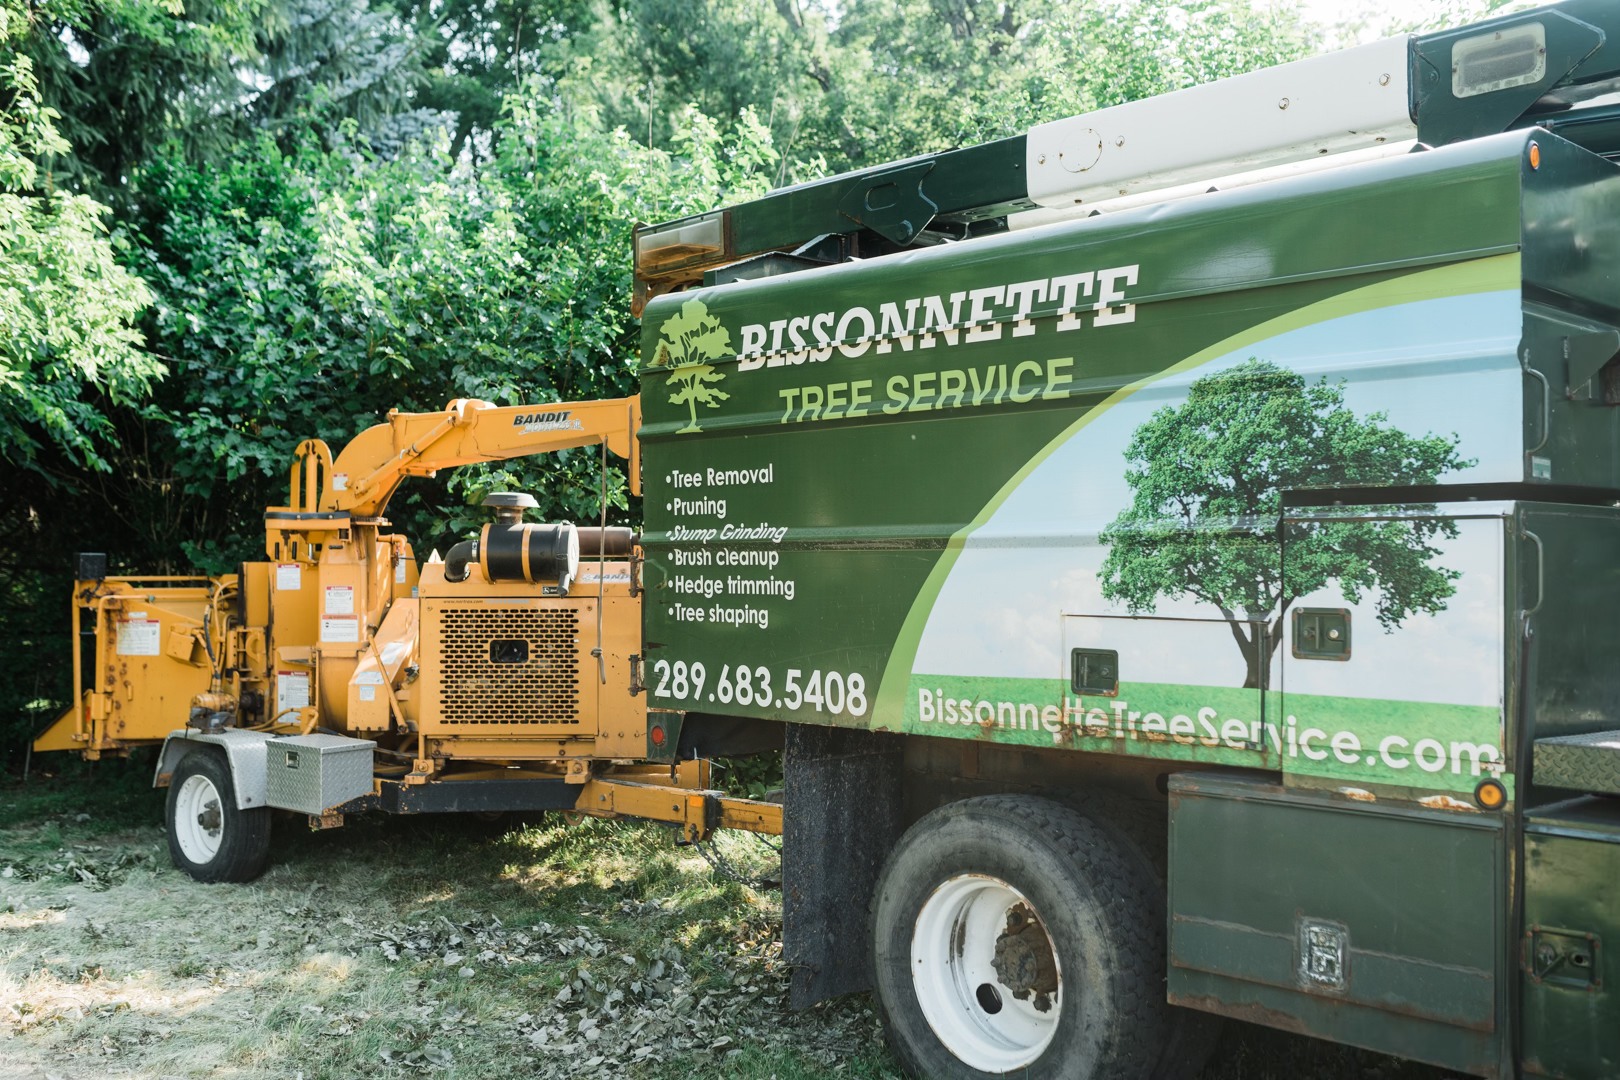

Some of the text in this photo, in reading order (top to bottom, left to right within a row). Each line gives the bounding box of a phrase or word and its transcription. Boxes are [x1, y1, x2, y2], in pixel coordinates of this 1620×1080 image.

[737, 264, 1140, 372] BISSONNETTE
[779, 357, 1074, 423] TREE SERVICE
[513, 411, 571, 426] BANDIT
[672, 463, 774, 488] Tree Removal
[673, 496, 726, 518] Pruning
[670, 522, 788, 544] Stump Grinding
[674, 547, 779, 570] Brush cleanup
[675, 575, 795, 600] Hedge trimming
[675, 603, 769, 629] Tree shaping
[653, 659, 868, 717] 289.683.5408
[918, 688, 1502, 778] BissonnetteTreeService.com
